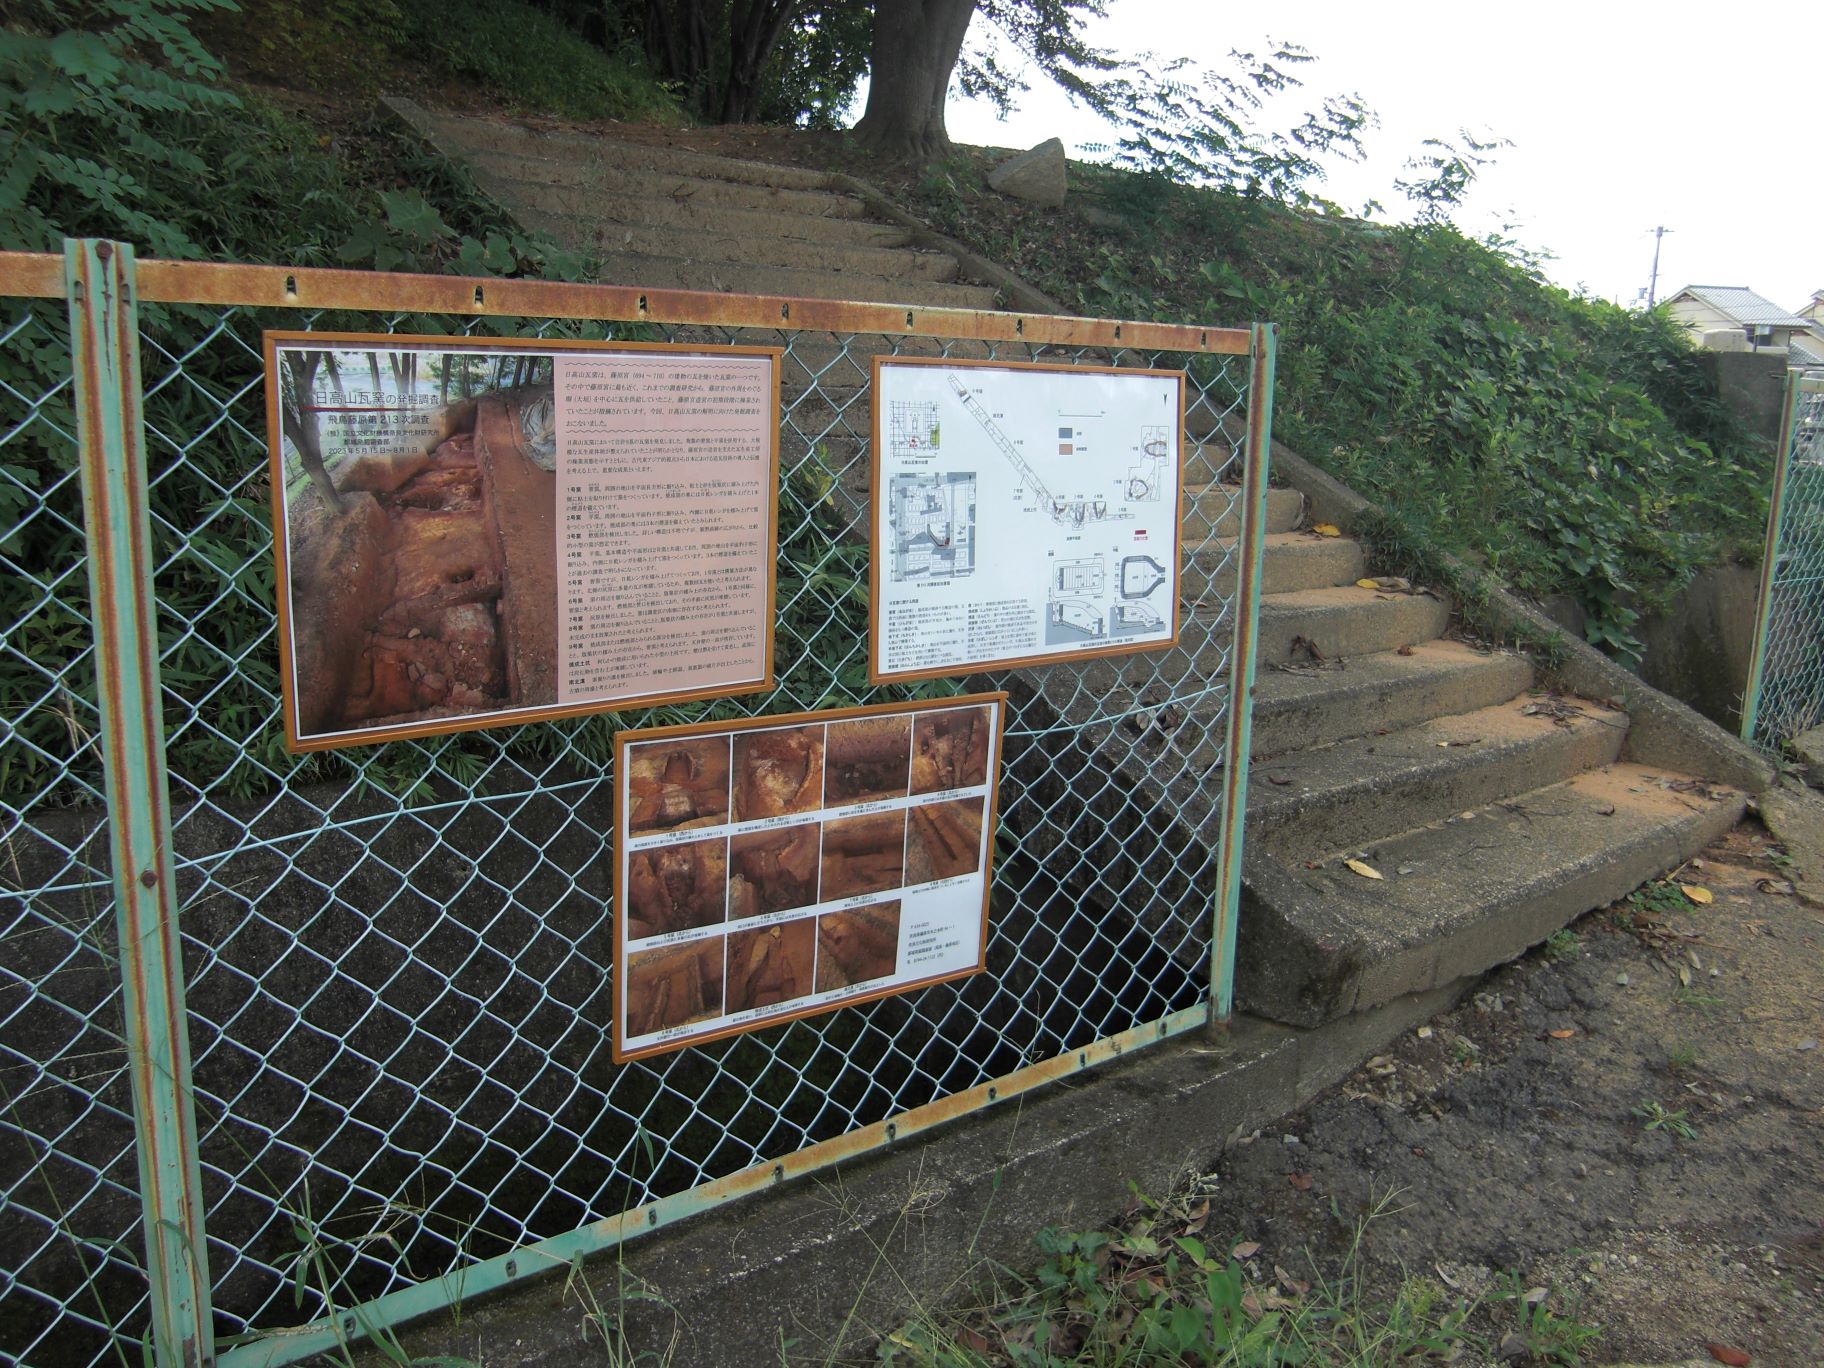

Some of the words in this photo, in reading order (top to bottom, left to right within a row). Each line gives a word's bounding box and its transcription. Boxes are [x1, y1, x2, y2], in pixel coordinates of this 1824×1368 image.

[316, 390, 440, 405] 日高山瓦窯の発掘調査
